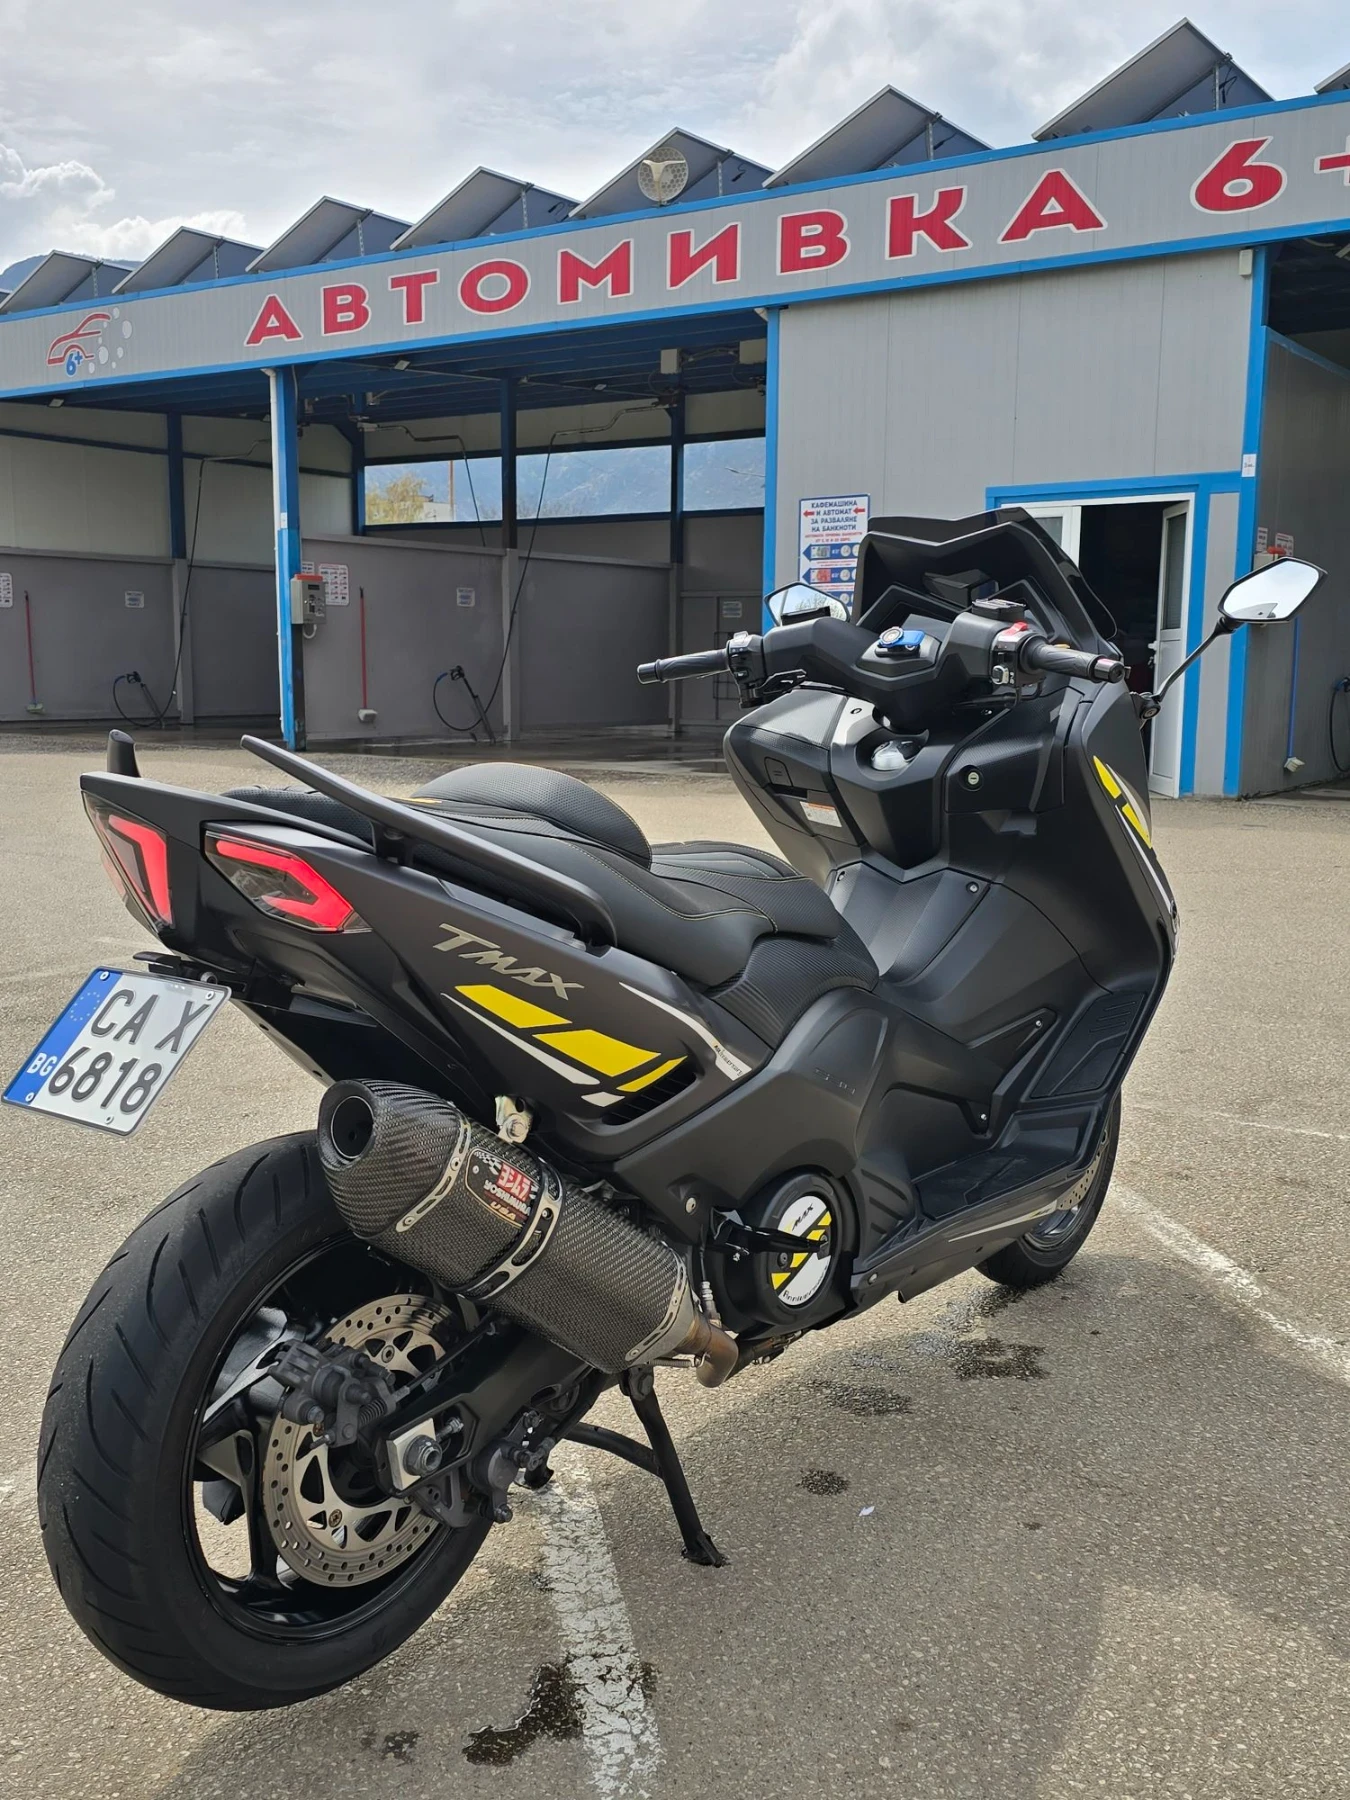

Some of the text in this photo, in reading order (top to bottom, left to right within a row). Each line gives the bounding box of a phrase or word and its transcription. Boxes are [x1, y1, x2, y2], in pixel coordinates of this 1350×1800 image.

[244, 167, 1107, 346] АВТОМИВКА
[66, 350, 84, 377] 6+
[823, 508, 852, 516] АВТОМАТ
[433, 923, 584, 1000] TMAX
[91, 989, 210, 1053] CA X
[27, 1053, 58, 1076] BG
[49, 1047, 163, 1114] 6818
[484, 1180, 531, 1216] YOSHIMURA
[490, 1201, 516, 1221] USA
